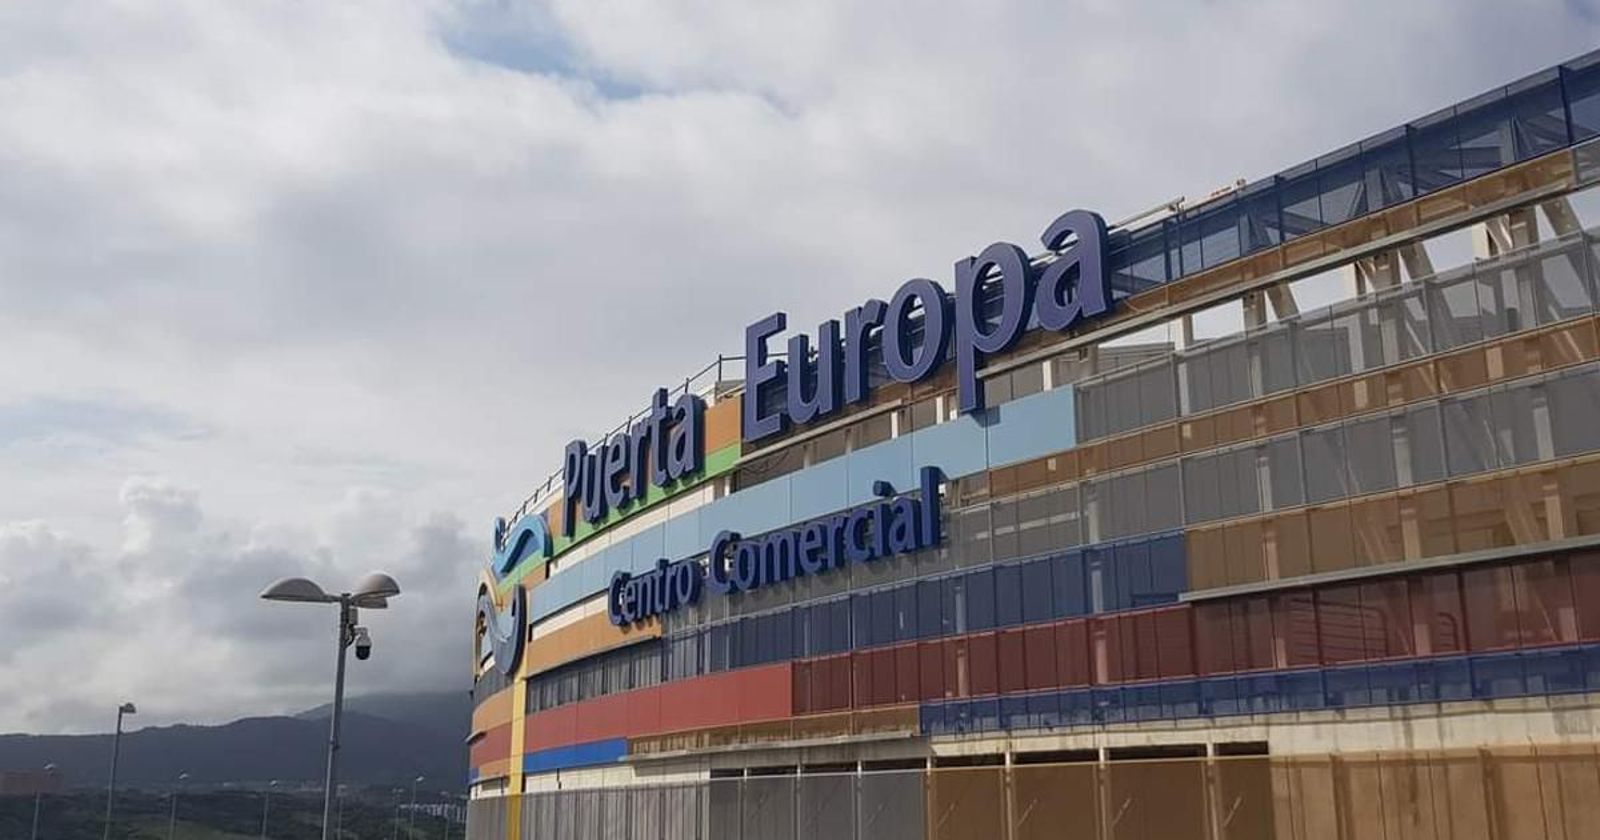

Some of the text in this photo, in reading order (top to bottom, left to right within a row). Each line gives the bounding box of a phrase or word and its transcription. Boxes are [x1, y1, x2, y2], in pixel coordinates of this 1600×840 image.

[562, 209, 1112, 536] Puerta Europa
[608, 466, 942, 627] Centro Comercial
